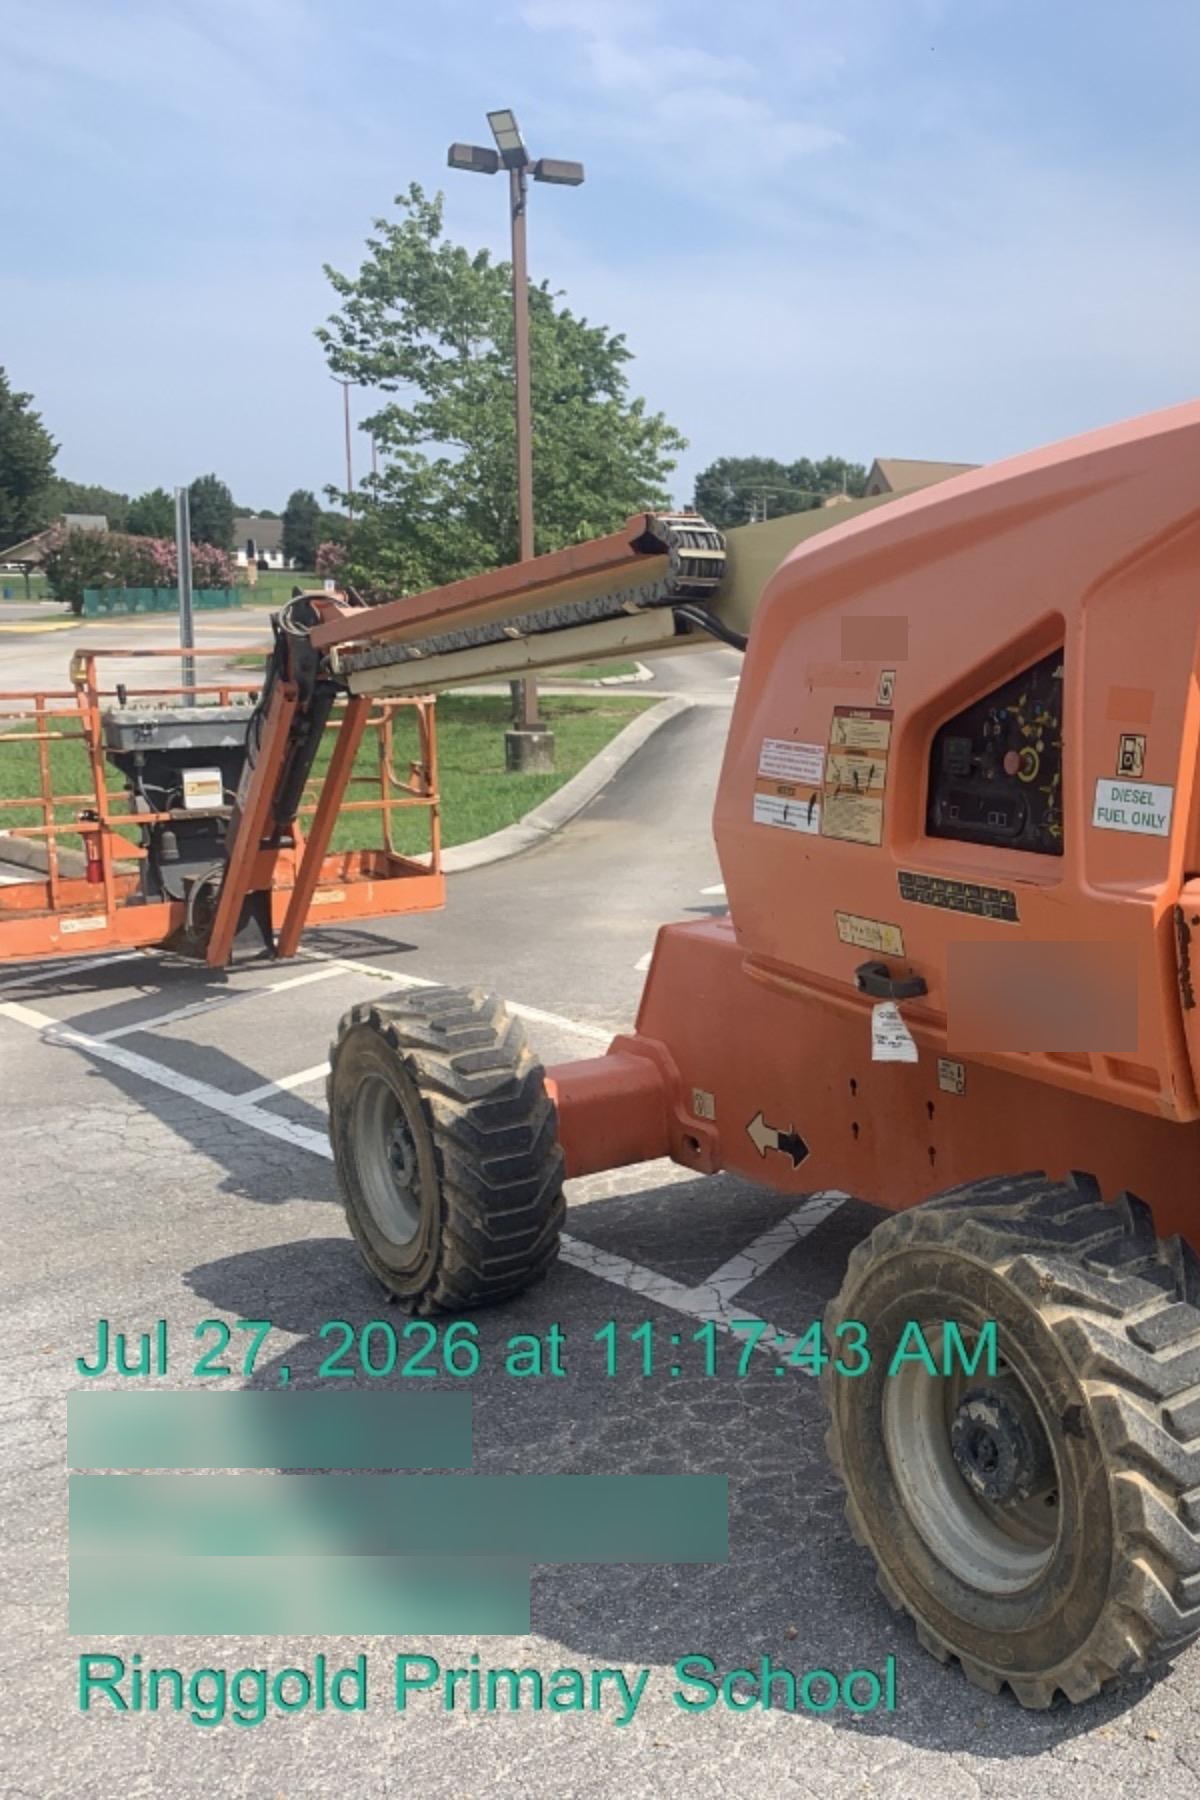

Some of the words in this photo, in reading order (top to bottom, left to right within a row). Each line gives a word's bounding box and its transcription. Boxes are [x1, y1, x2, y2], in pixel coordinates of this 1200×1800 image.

[1111, 787, 1155, 806] DIESEL
[1097, 807, 1128, 825] FUEL
[1131, 811, 1167, 829] ONLY
